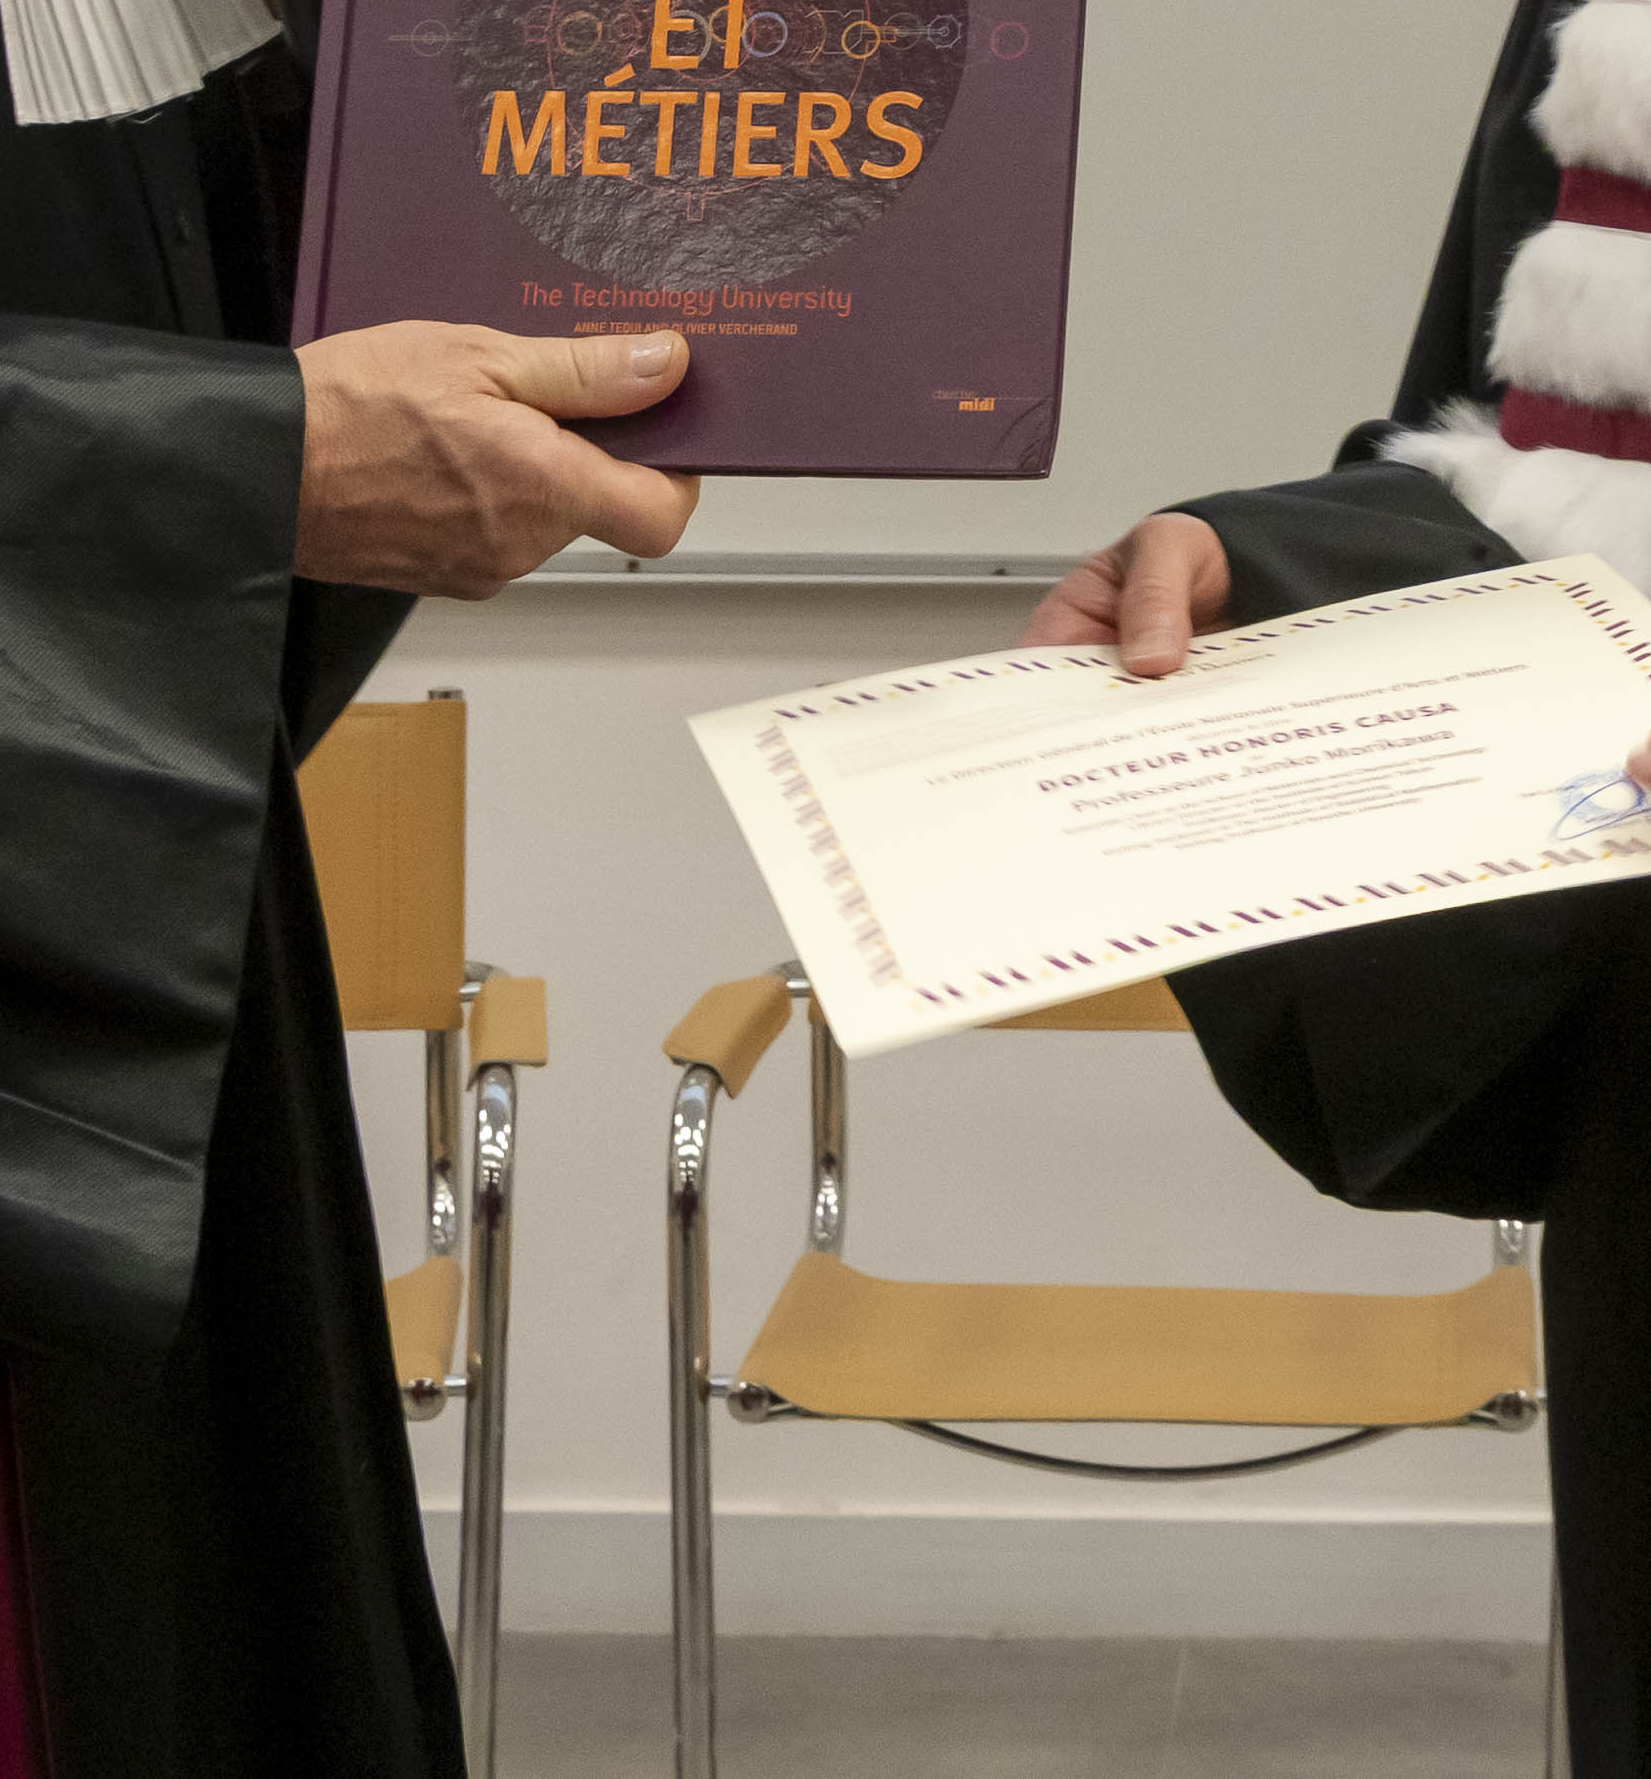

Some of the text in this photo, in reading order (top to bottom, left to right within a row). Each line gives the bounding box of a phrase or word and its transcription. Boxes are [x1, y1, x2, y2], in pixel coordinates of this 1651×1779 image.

[482, 63, 924, 179] MÉTIERS
[520, 281, 852, 317] The Technology University
[574, 322, 607, 333] ANNE
[1037, 751, 1190, 793] DOCTEUR
[1197, 722, 1347, 758] HONORIS
[1355, 702, 1459, 728] CAUSA
